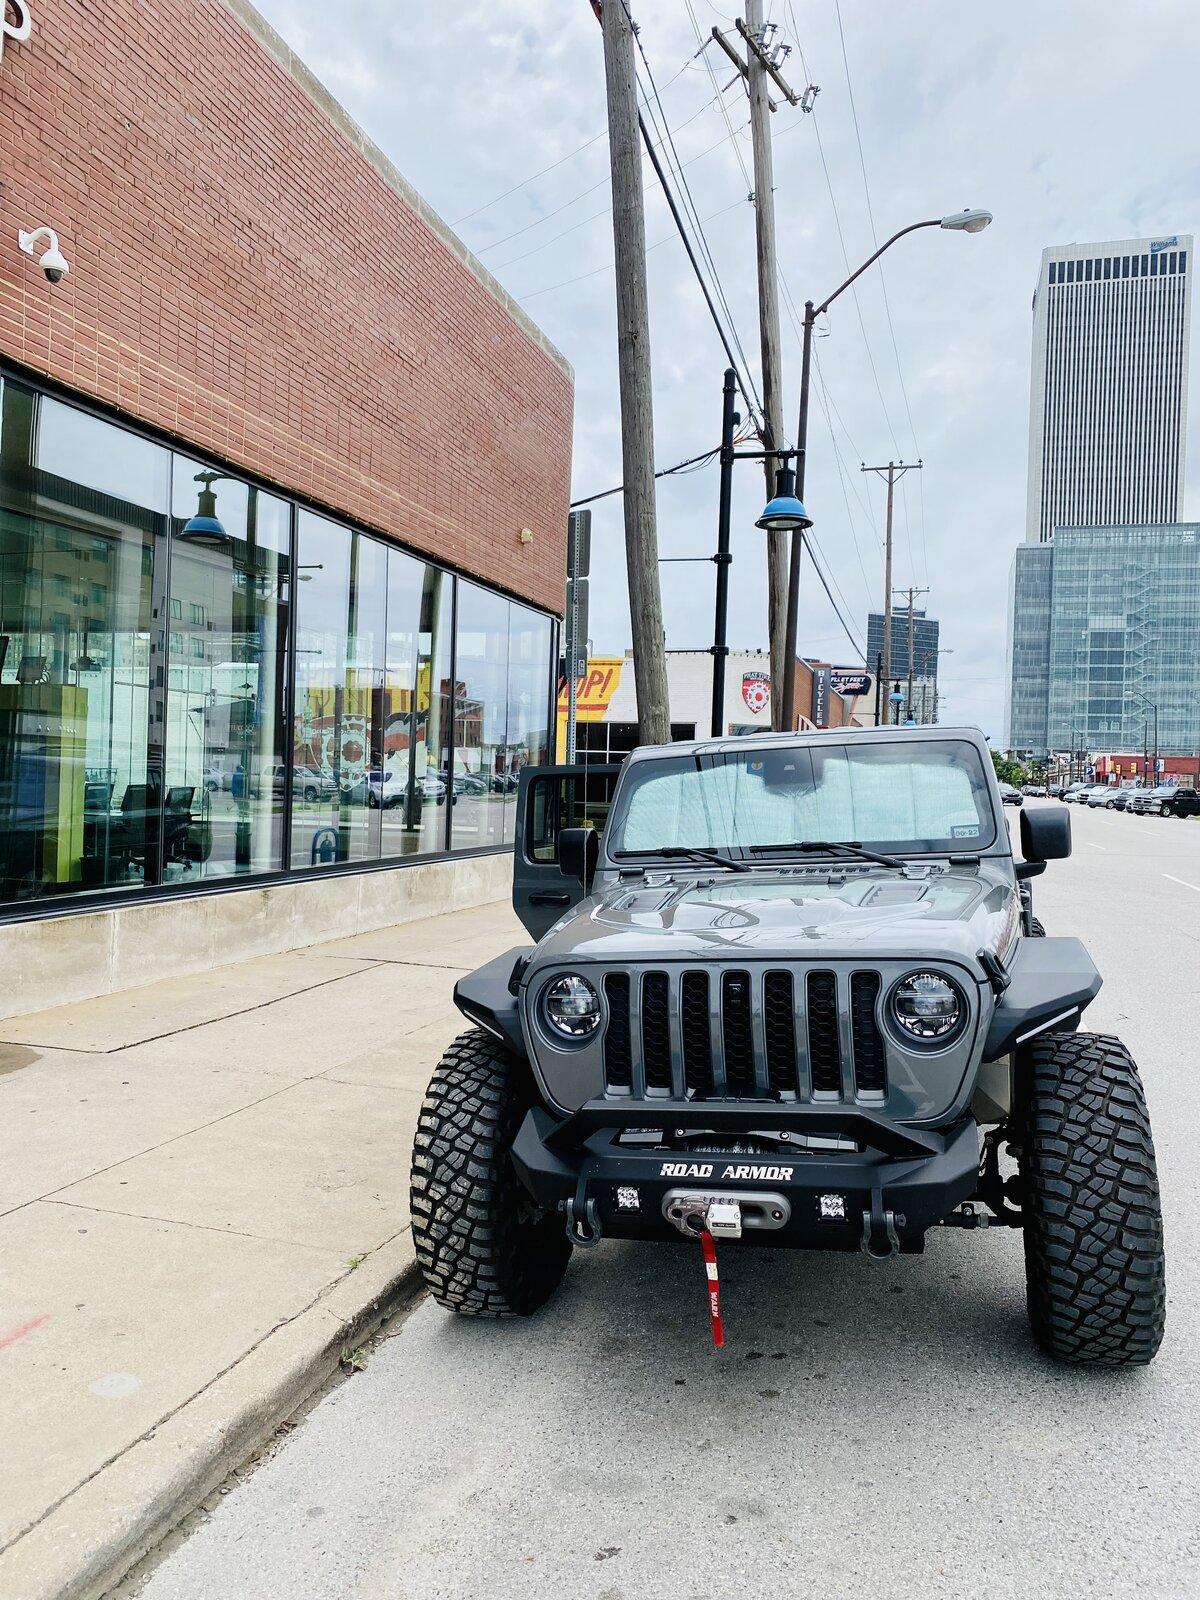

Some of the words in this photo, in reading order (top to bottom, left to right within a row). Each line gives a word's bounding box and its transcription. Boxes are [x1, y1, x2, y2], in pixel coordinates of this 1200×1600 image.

[660, 1163, 714, 1178] ROAD
[721, 1165, 794, 1181] ARMOR
[710, 1291, 719, 1318] WARN
